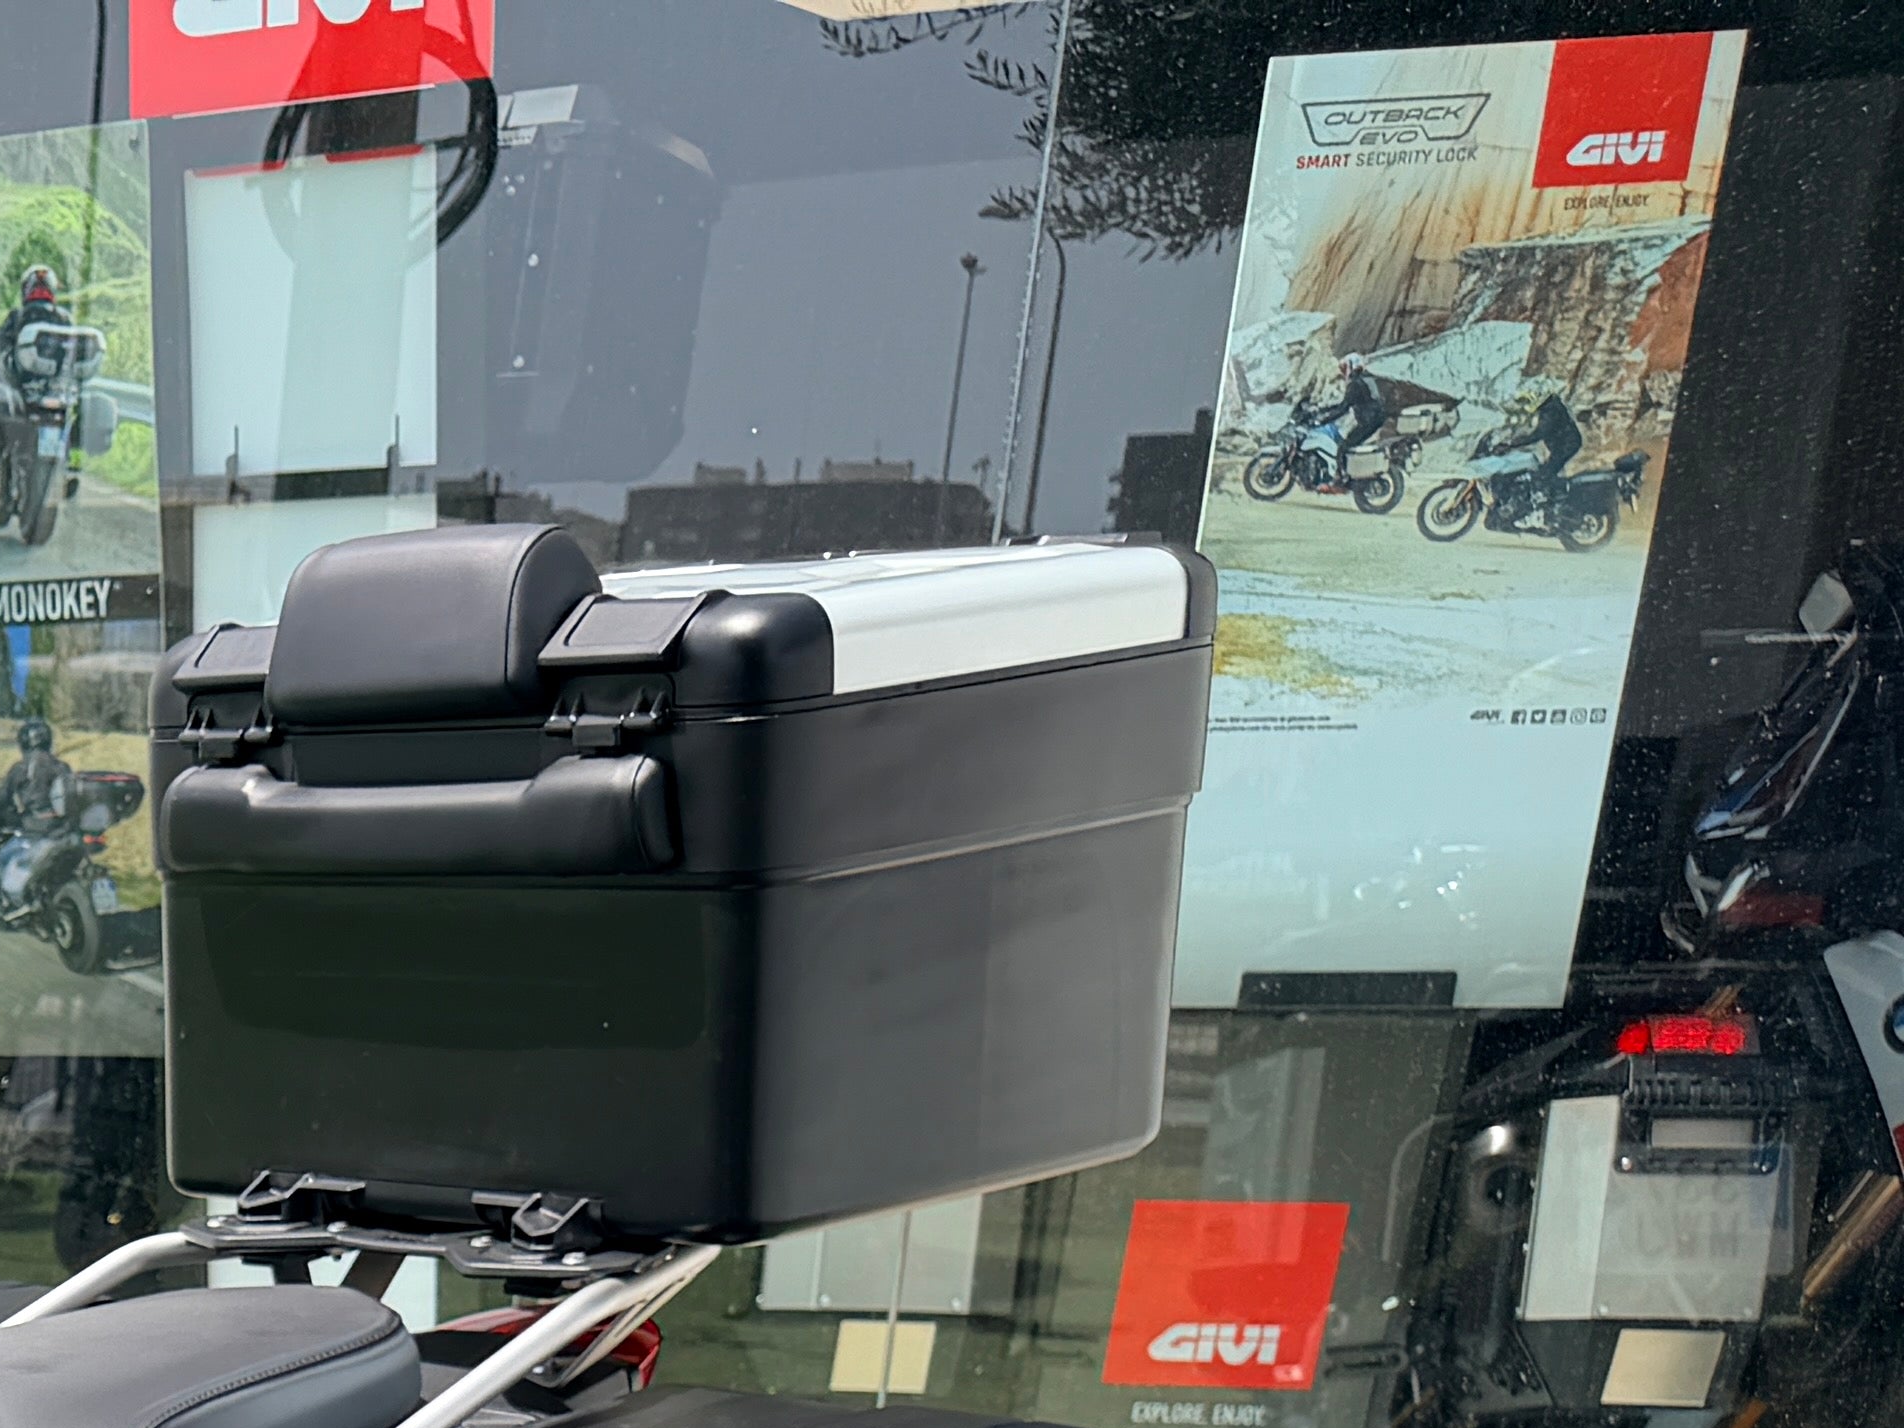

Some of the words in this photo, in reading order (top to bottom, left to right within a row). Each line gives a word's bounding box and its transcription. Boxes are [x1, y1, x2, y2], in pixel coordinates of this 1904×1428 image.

[1323, 104, 1466, 127] OUTBACK
[1359, 129, 1419, 146] EVO
[1566, 130, 1667, 167] GIVI
[1296, 153, 1352, 170] SMART
[1355, 149, 1432, 168] SECURITY
[1436, 146, 1479, 164] LOCK
[1147, 1322, 1282, 1366] GIVI
